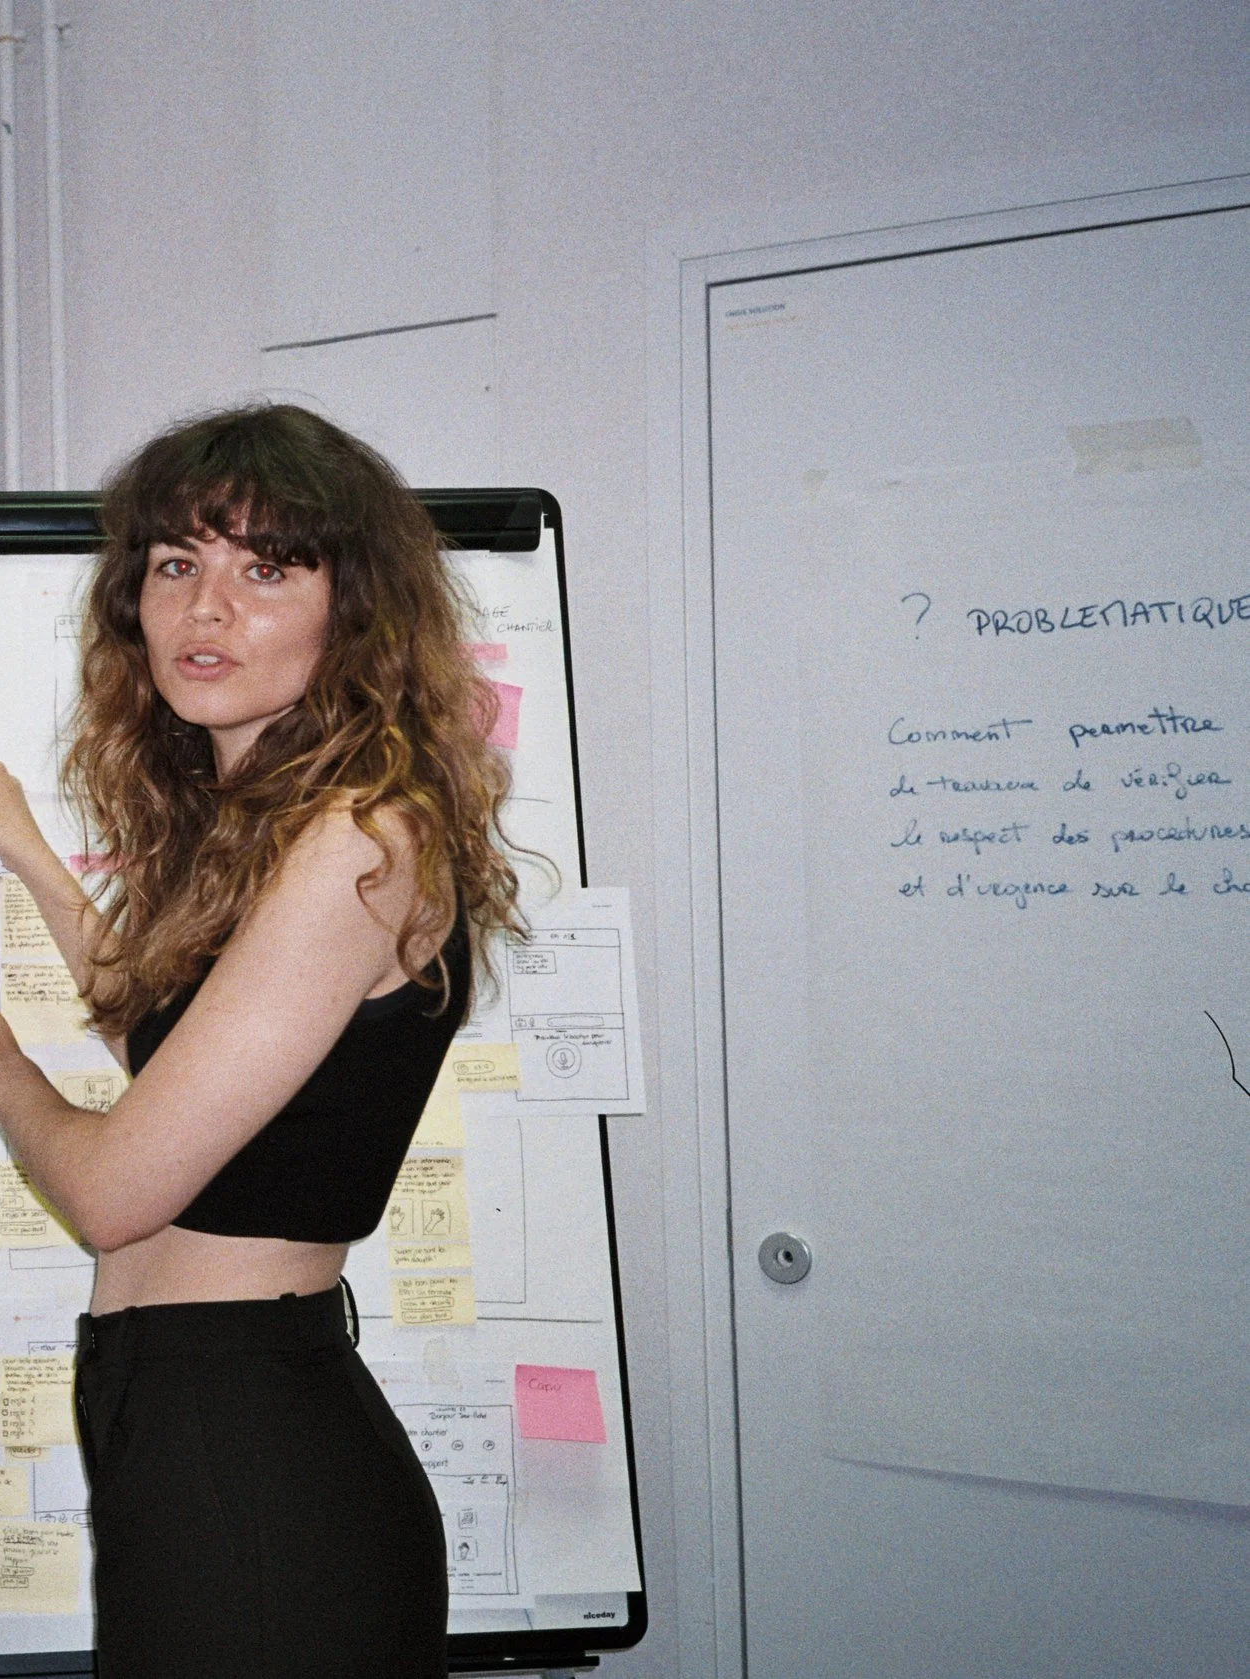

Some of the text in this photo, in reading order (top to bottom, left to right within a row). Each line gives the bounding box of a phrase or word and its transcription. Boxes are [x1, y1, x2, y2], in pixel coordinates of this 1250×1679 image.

[481, 605, 511, 618] AGE
[966, 593, 1250, 637] PROBLEMATIQUE
[887, 705, 1225, 749] Comment permettre
[1062, 769, 1093, 792] de
[938, 822, 1031, 856] respect
[1052, 822, 1092, 846] des
[898, 874, 926, 898] et
[946, 873, 1070, 910] d'urgence
[583, 1610, 616, 1620] niceday
